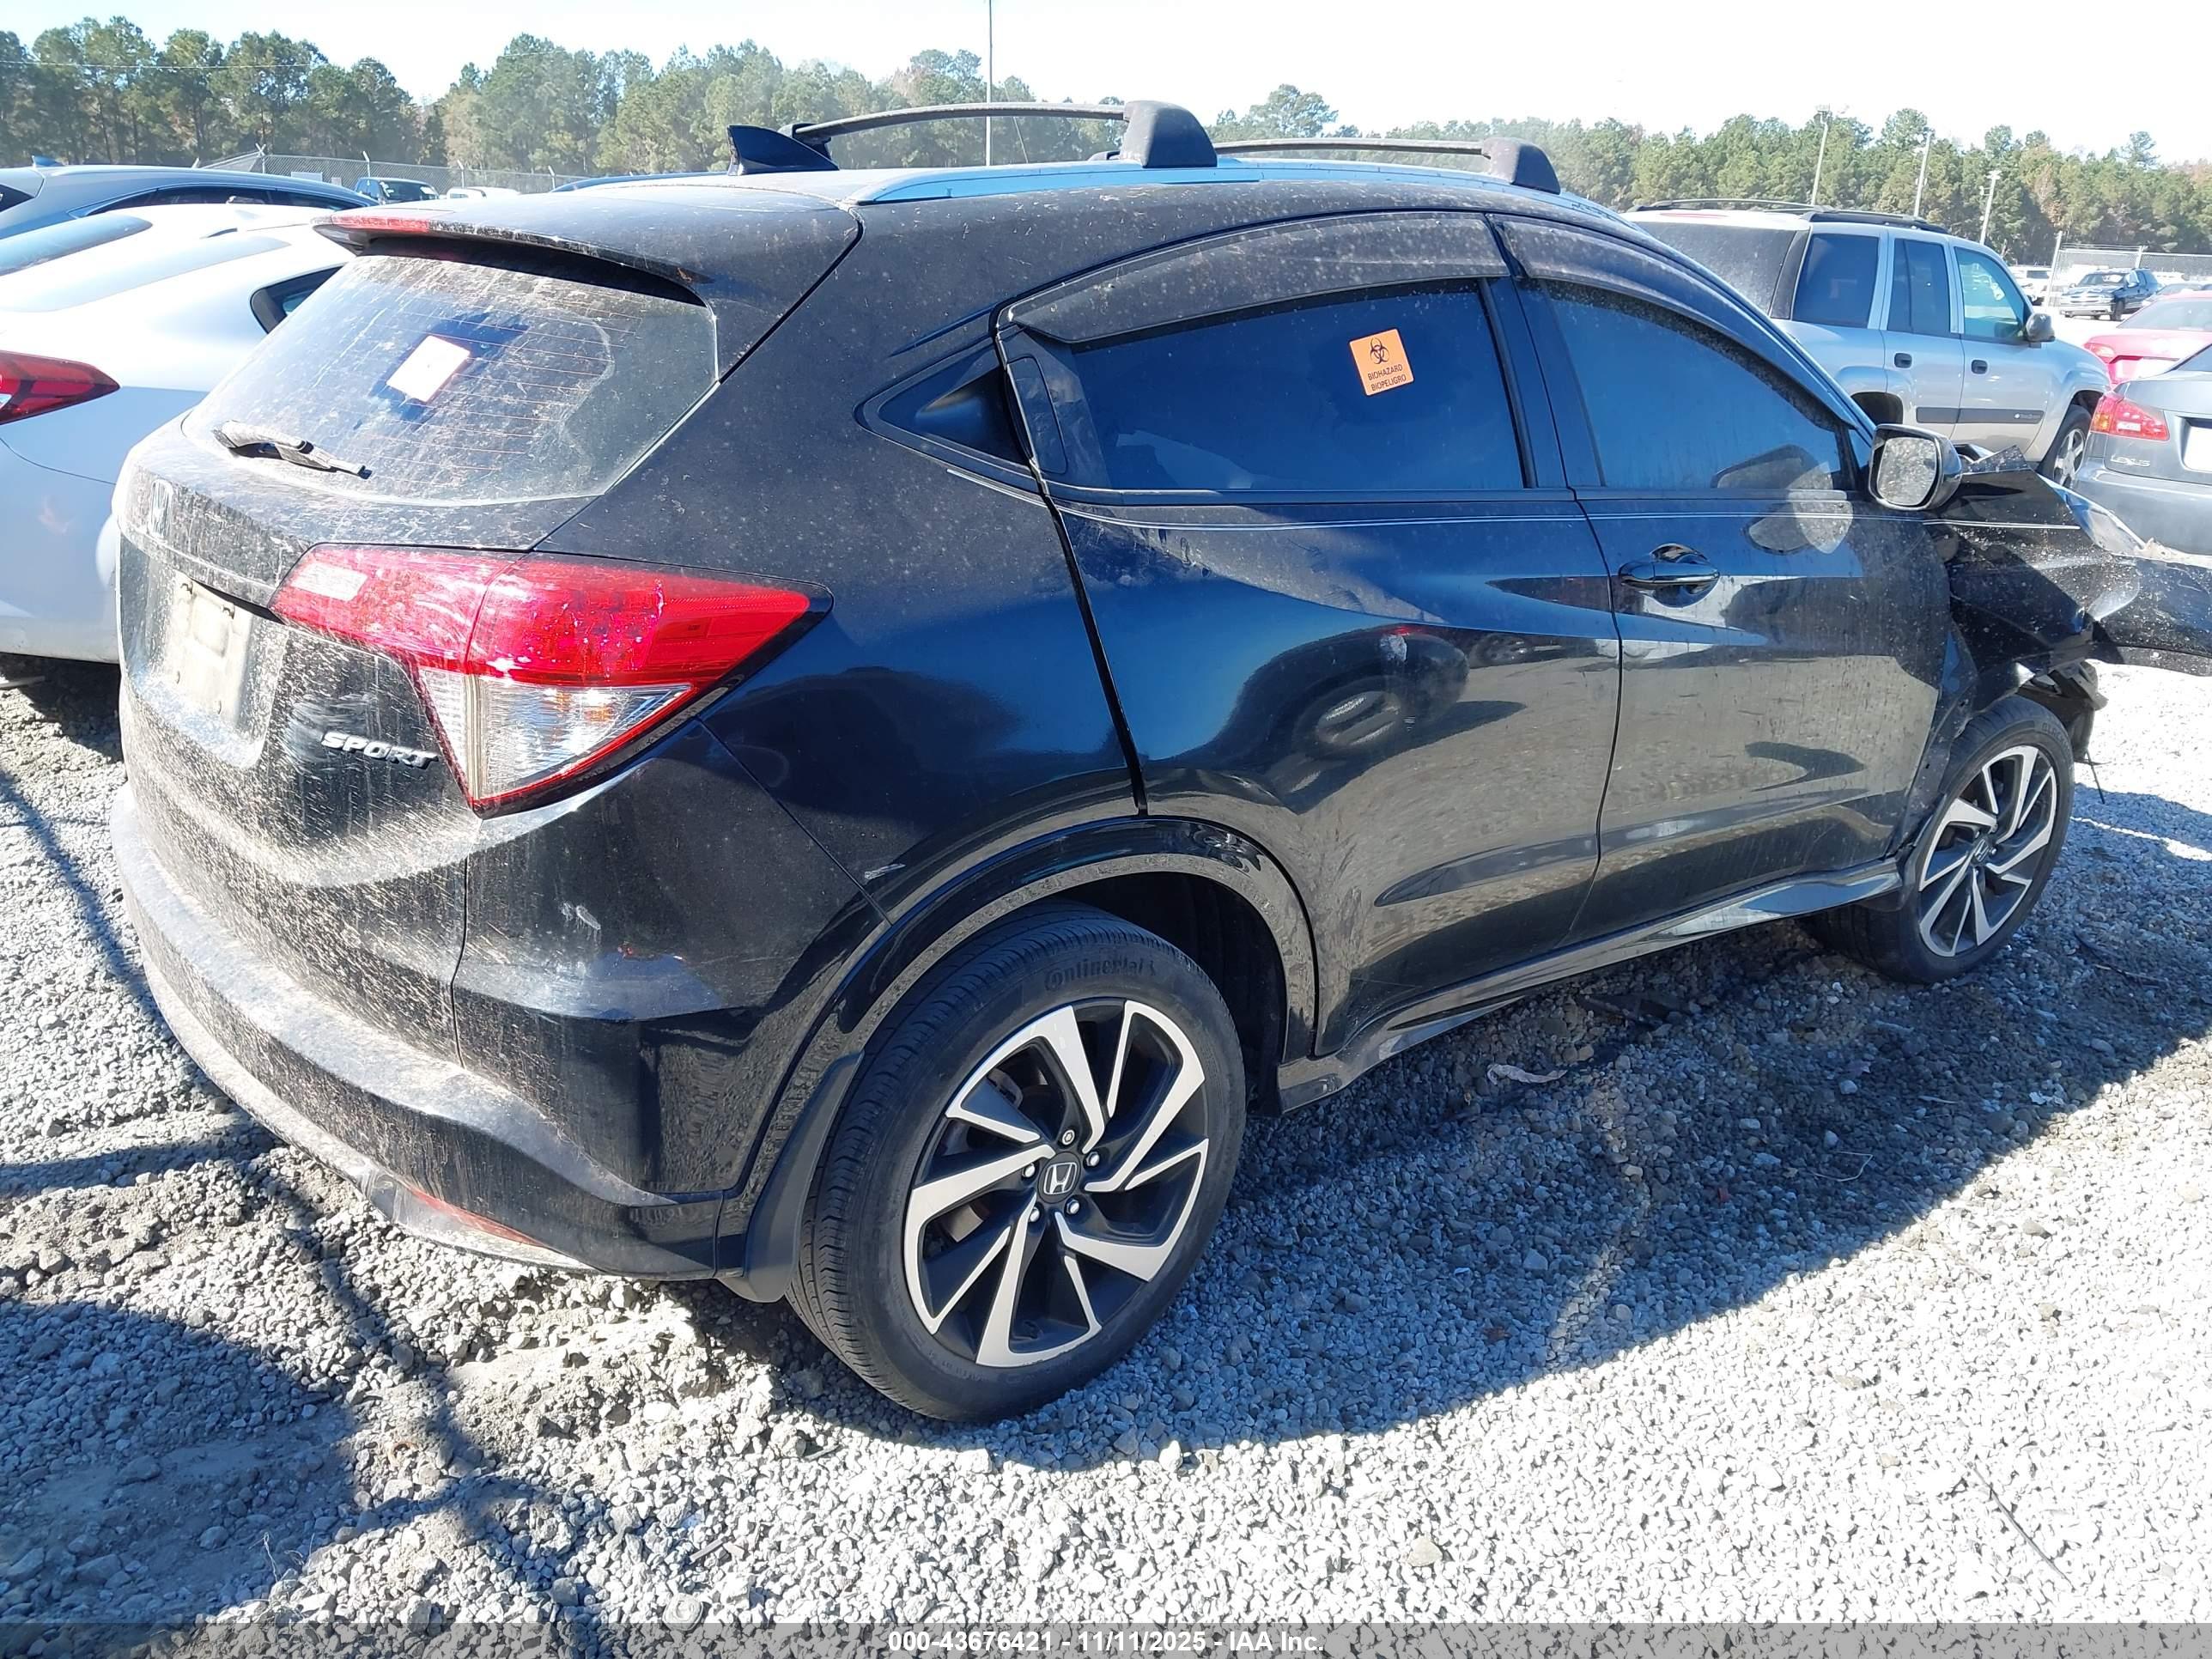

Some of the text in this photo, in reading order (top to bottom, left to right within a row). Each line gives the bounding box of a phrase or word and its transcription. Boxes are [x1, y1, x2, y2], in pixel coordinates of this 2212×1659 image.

[1368, 365, 1403, 380] BIOHAZARD
[1371, 374, 1407, 391] BIOPELIGRO
[2110, 454, 2151, 468] LEXUS
[321, 732, 440, 769] SPORT
[1043, 957, 1144, 992] Continental
